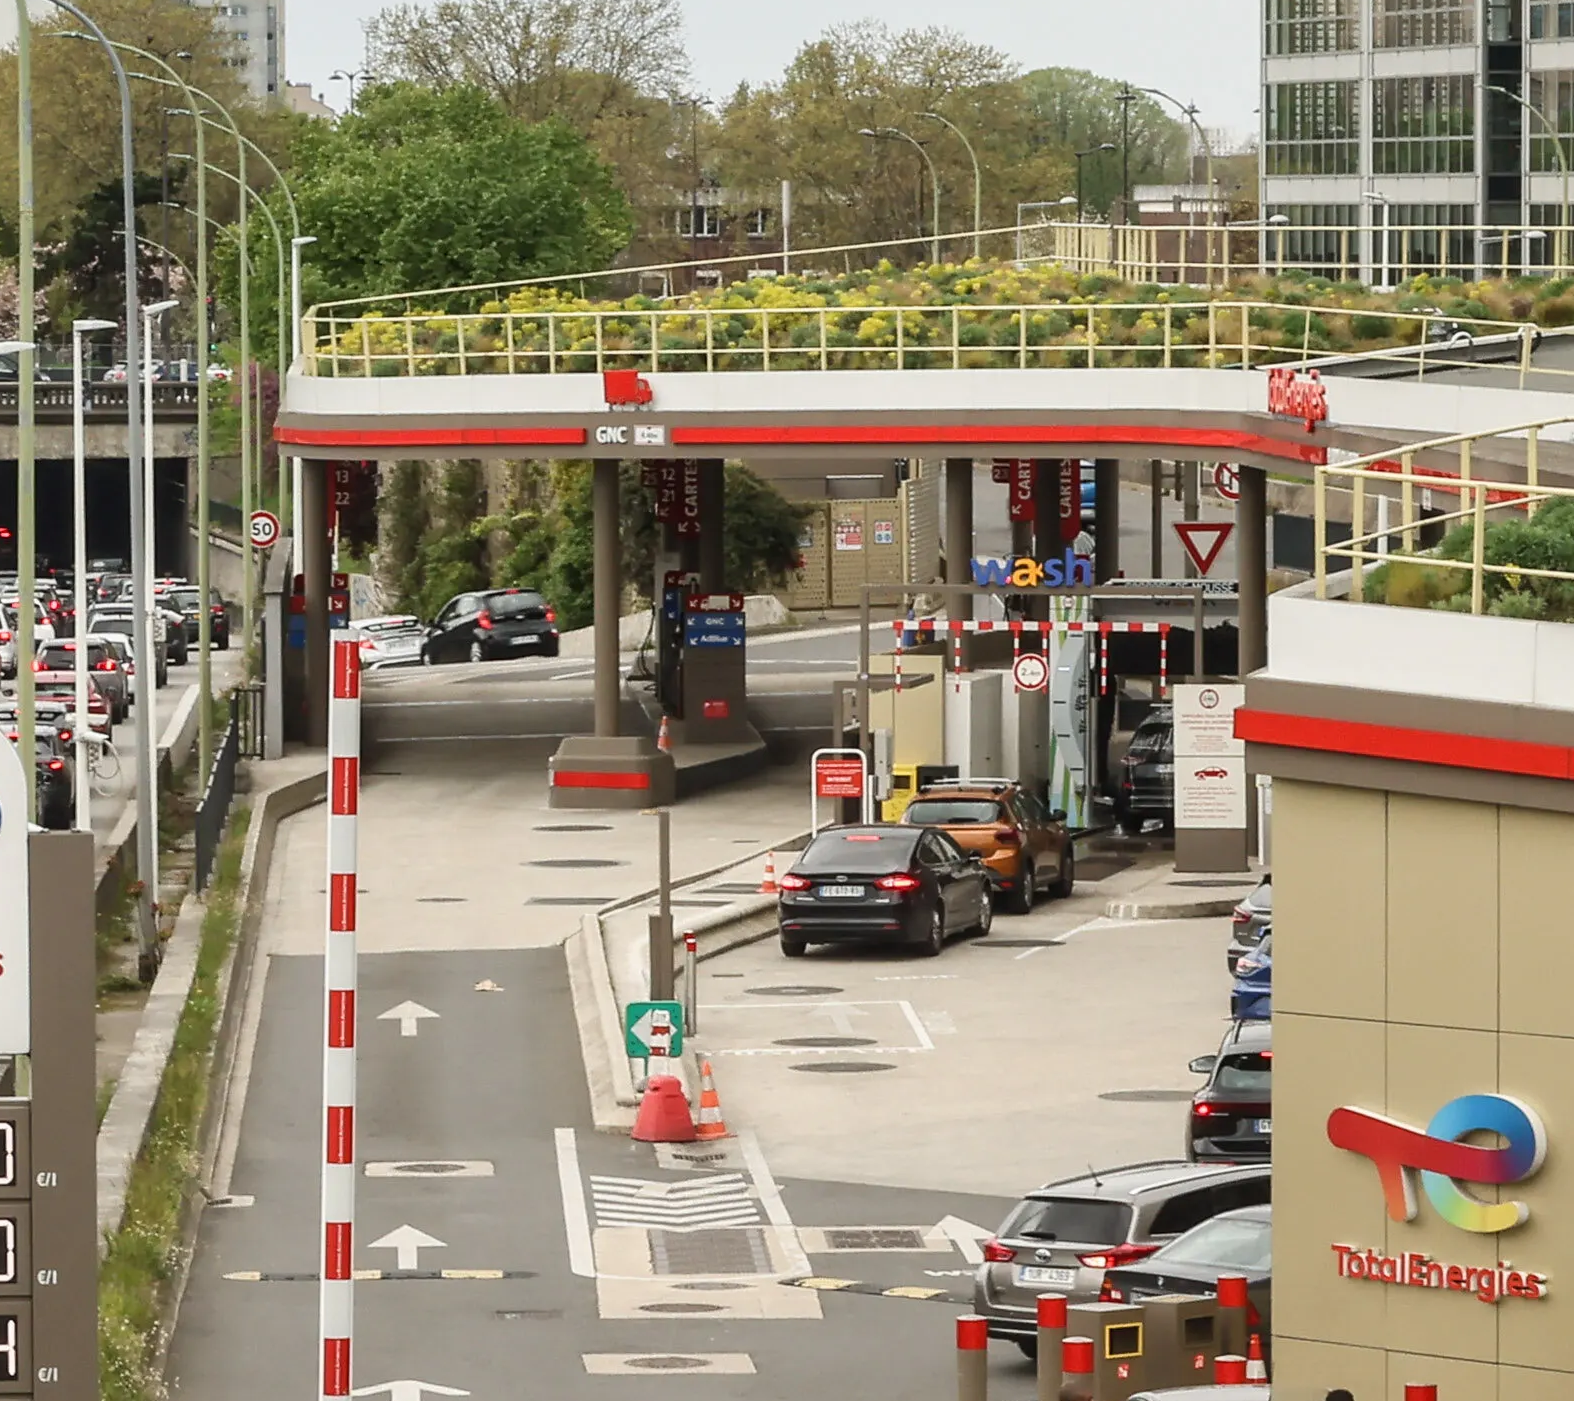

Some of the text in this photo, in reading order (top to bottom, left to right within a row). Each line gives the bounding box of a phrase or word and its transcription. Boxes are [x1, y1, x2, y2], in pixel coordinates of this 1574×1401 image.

[596, 426, 628, 443] GNC
[335, 470, 350, 483] 13
[1018, 461, 1031, 500] CART
[335, 492, 350, 505] 22
[252, 523, 272, 536] 50
[970, 547, 1092, 587] wash
[1331, 1243, 1549, 1303] TotalEnergies
